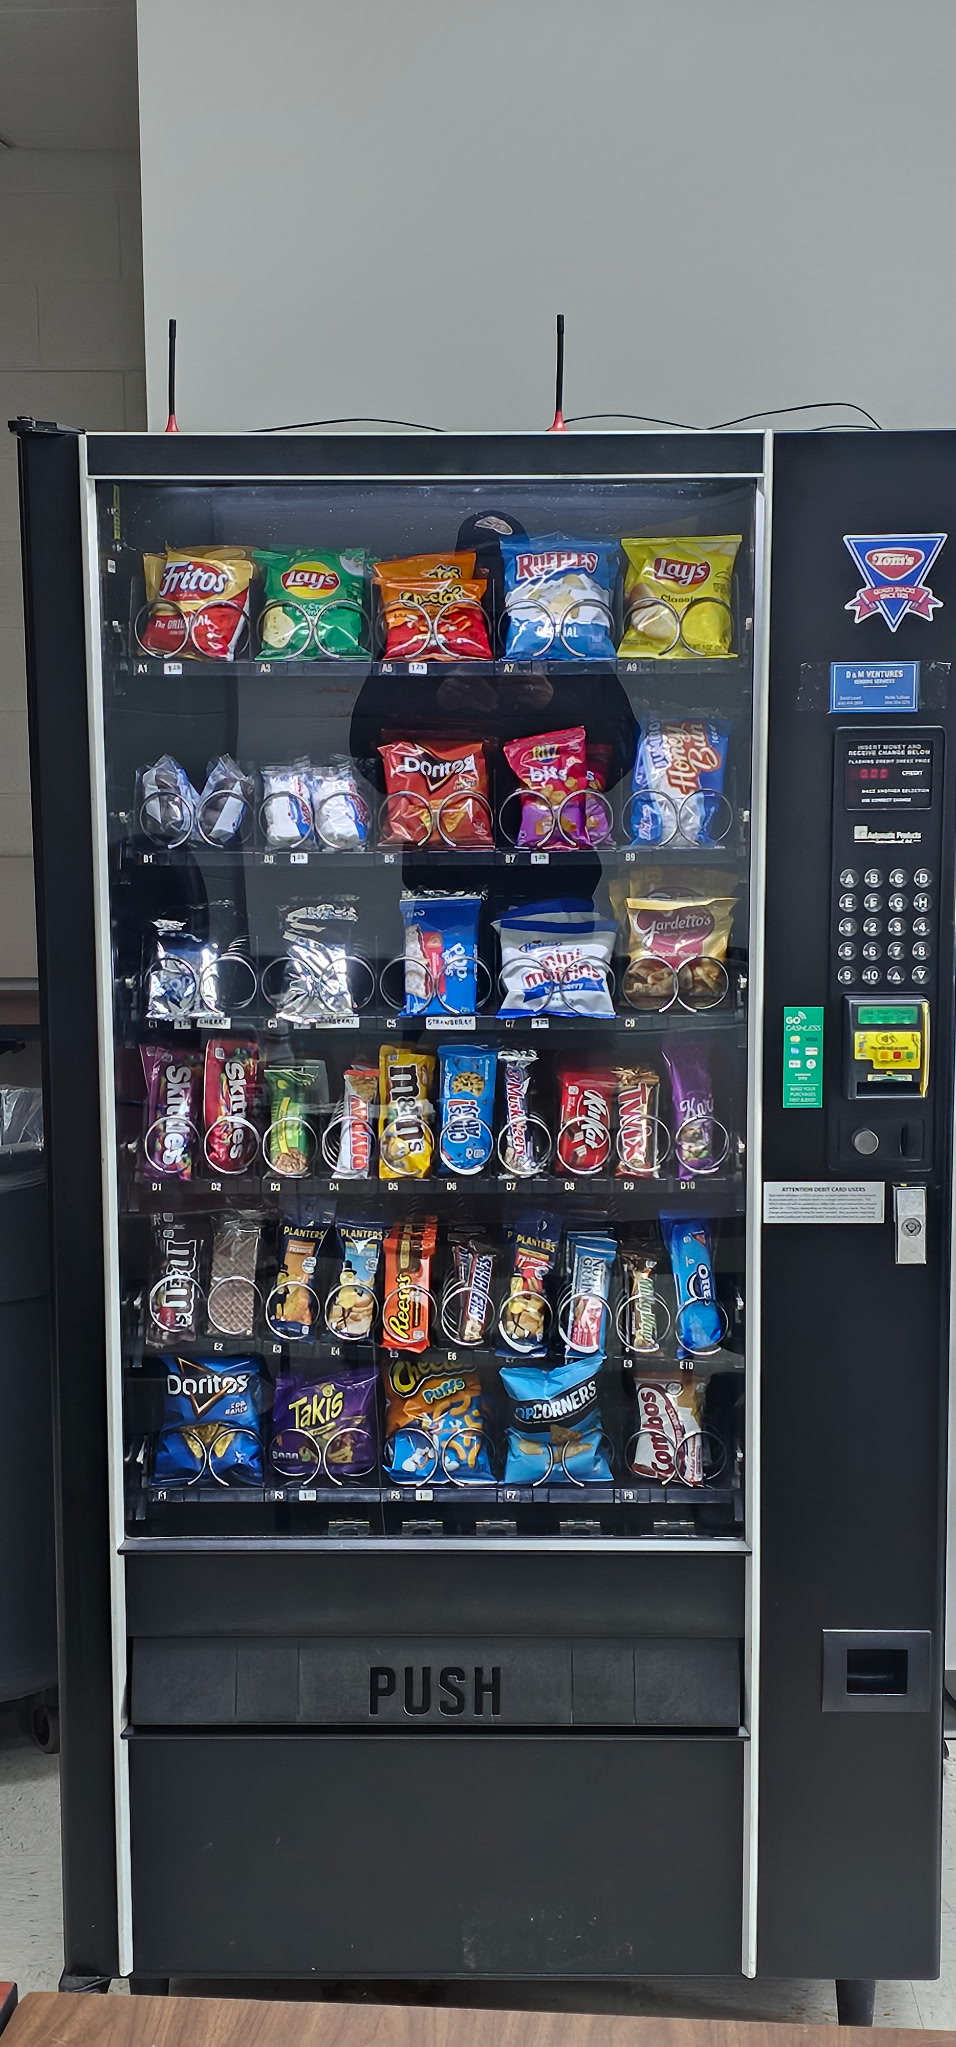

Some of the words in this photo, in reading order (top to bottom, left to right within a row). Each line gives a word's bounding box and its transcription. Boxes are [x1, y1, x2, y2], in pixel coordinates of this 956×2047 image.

[872, 553, 915, 566] Tom's
[517, 552, 598, 580] RUFFLES
[657, 558, 708, 585] Lay's
[159, 561, 228, 597] Fritos
[286, 570, 337, 590] Lay's
[138, 664, 149, 674] A1
[261, 664, 271, 673] A3
[382, 664, 393, 673] A5
[503, 663, 514, 673] A7
[627, 663, 637, 672] A9
[846, 670, 852, 679] D
[857, 670, 865, 678] M
[866, 670, 904, 678] VENTURES
[532, 745, 559, 760] RITZ
[668, 723, 698, 793] Honey
[688, 723, 719, 771] Bun
[403, 754, 475, 778] Doritos
[530, 767, 568, 783] bits
[143, 855, 154, 864] B1
[384, 855, 395, 864] B5
[505, 855, 516, 864] B7
[625, 853, 636, 862] B9
[844, 874, 854, 884] A
[870, 874, 878, 884] B
[895, 873, 904, 884] C
[919, 874, 928, 883] D
[845, 898, 853, 908] E
[870, 898, 878, 908] F
[894, 897, 903, 908] G
[919, 897, 928, 908] H
[634, 913, 711, 949] Gardetto's
[845, 922, 852, 932] 1
[869, 922, 877, 932] 2
[894, 922, 902, 932] 3
[918, 922, 926, 932] 4
[844, 946, 852, 956] 5
[869, 946, 876, 956] 6
[893, 946, 901, 956] 7
[918, 946, 926, 956] 8
[525, 963, 601, 988] muffins
[844, 971, 851, 980] 9
[866, 970, 879, 980] 10
[148, 1020, 158, 1029] C1
[267, 1019, 278, 1028] C3
[386, 1019, 397, 1028] C5
[427, 1018, 472, 1026] STRAWBERRY
[505, 1019, 515, 1028] C7
[625, 1019, 636, 1028] C9
[786, 1016, 801, 1025] GO
[163, 1065, 192, 1165] Skittles
[224, 1061, 247, 1159] Skittles
[507, 1081, 526, 1159] Muskteers
[618, 1083, 647, 1161] TWIX
[350, 1096, 369, 1170] PAYDAY
[152, 1183, 162, 1191] D1
[211, 1183, 222, 1191] D2
[270, 1183, 281, 1191] D3
[329, 1183, 339, 1191] D4
[388, 1183, 399, 1191] D5
[446, 1183, 457, 1191] D6
[506, 1183, 517, 1191] D7
[564, 1182, 575, 1191] D8
[623, 1182, 635, 1191] D9
[680, 1181, 696, 1190] D10
[284, 1226, 325, 1240] PLANTERS
[340, 1228, 383, 1241] PLANTERS
[516, 1234, 556, 1253] PLANTERS
[581, 1257, 593, 1294] GRAIN
[390, 1274, 411, 1339] Reese's
[214, 1343, 224, 1351] E2
[273, 1345, 282, 1354] E3
[331, 1347, 340, 1356] E4
[447, 1352, 457, 1361] E6
[623, 1360, 633, 1368] E9
[679, 1361, 694, 1370] E10
[167, 1374, 248, 1396] Doritos
[423, 1378, 466, 1403] Puffs
[515, 1381, 598, 1420] OPCORNERS
[289, 1384, 344, 1429] Takis
[640, 1392, 676, 1475] Combos
[158, 1491, 167, 1500] F1
[274, 1491, 284, 1499] F3
[391, 1491, 401, 1500] F5
[506, 1491, 516, 1500] F7
[624, 1491, 634, 1500] F9
[369, 1666, 501, 1717] PUSH
